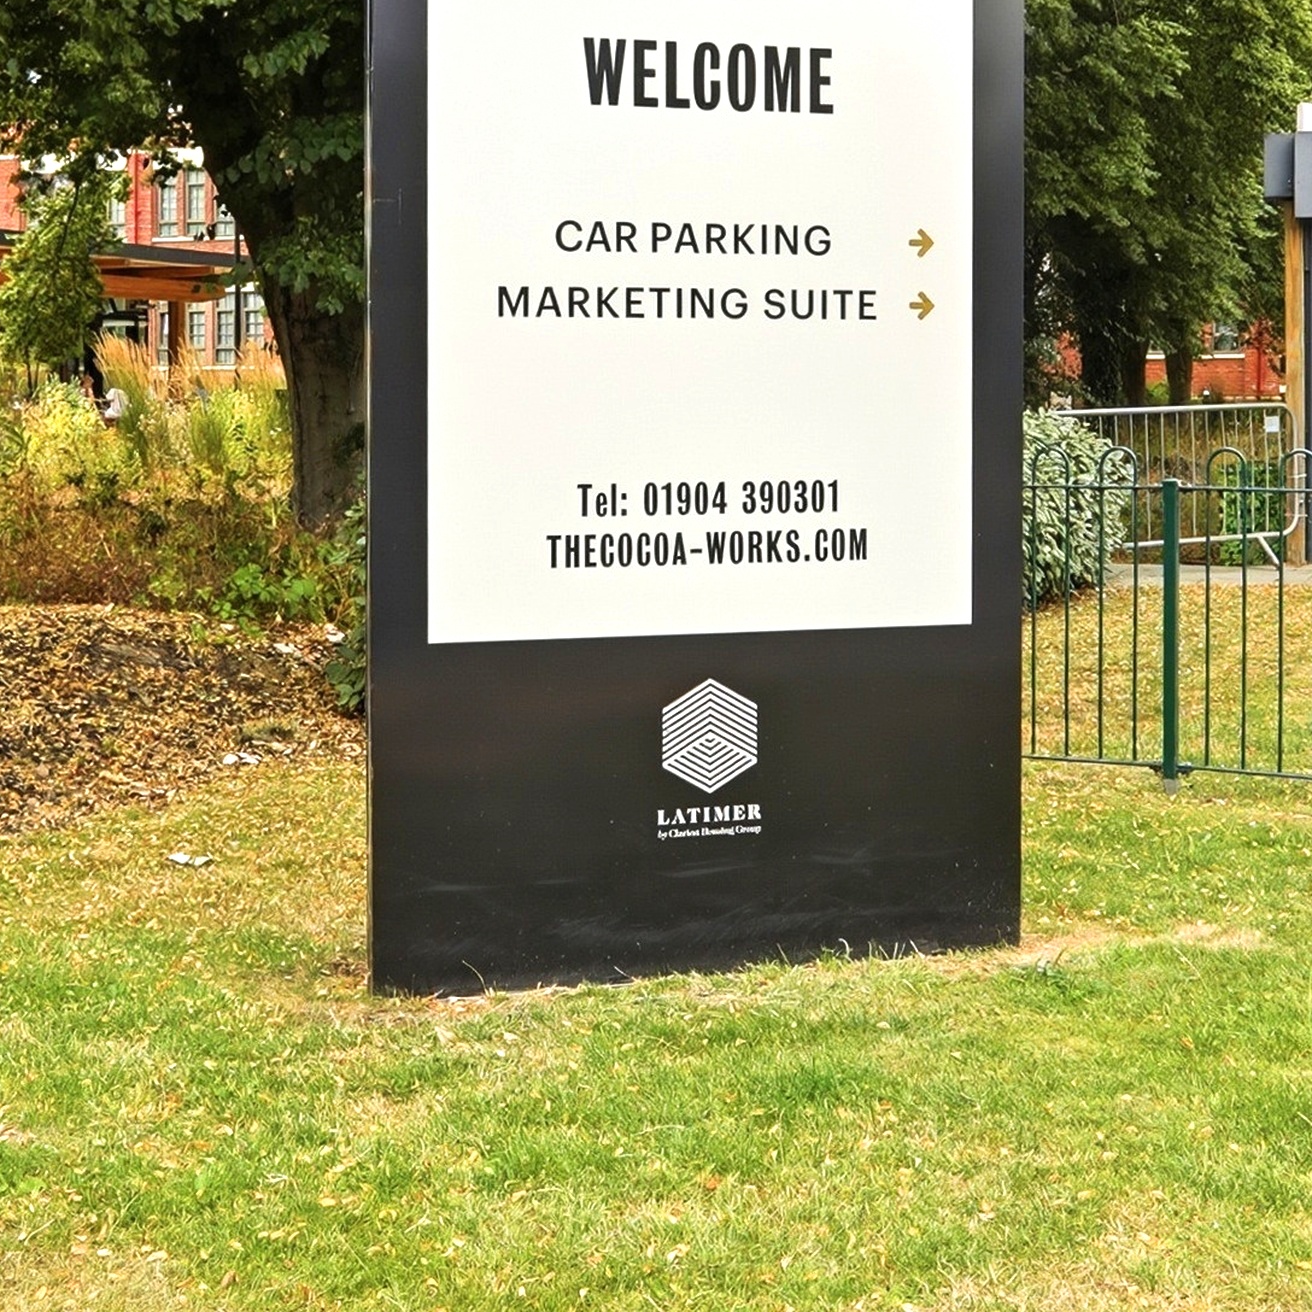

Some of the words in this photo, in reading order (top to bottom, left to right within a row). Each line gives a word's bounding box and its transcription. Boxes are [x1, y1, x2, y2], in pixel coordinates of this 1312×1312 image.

[583, 36, 834, 115] WELCOME
[555, 220, 638, 254] CAR
[651, 222, 833, 257] PARKING
[497, 285, 749, 320] MARKETING
[763, 288, 878, 321] SUITE
[576, 482, 629, 518] Tel:
[643, 481, 728, 517] 01904
[741, 479, 839, 515] 390301
[545, 527, 869, 569] THECOCOA-WORKS.COM
[657, 803, 762, 826] LATIMER
